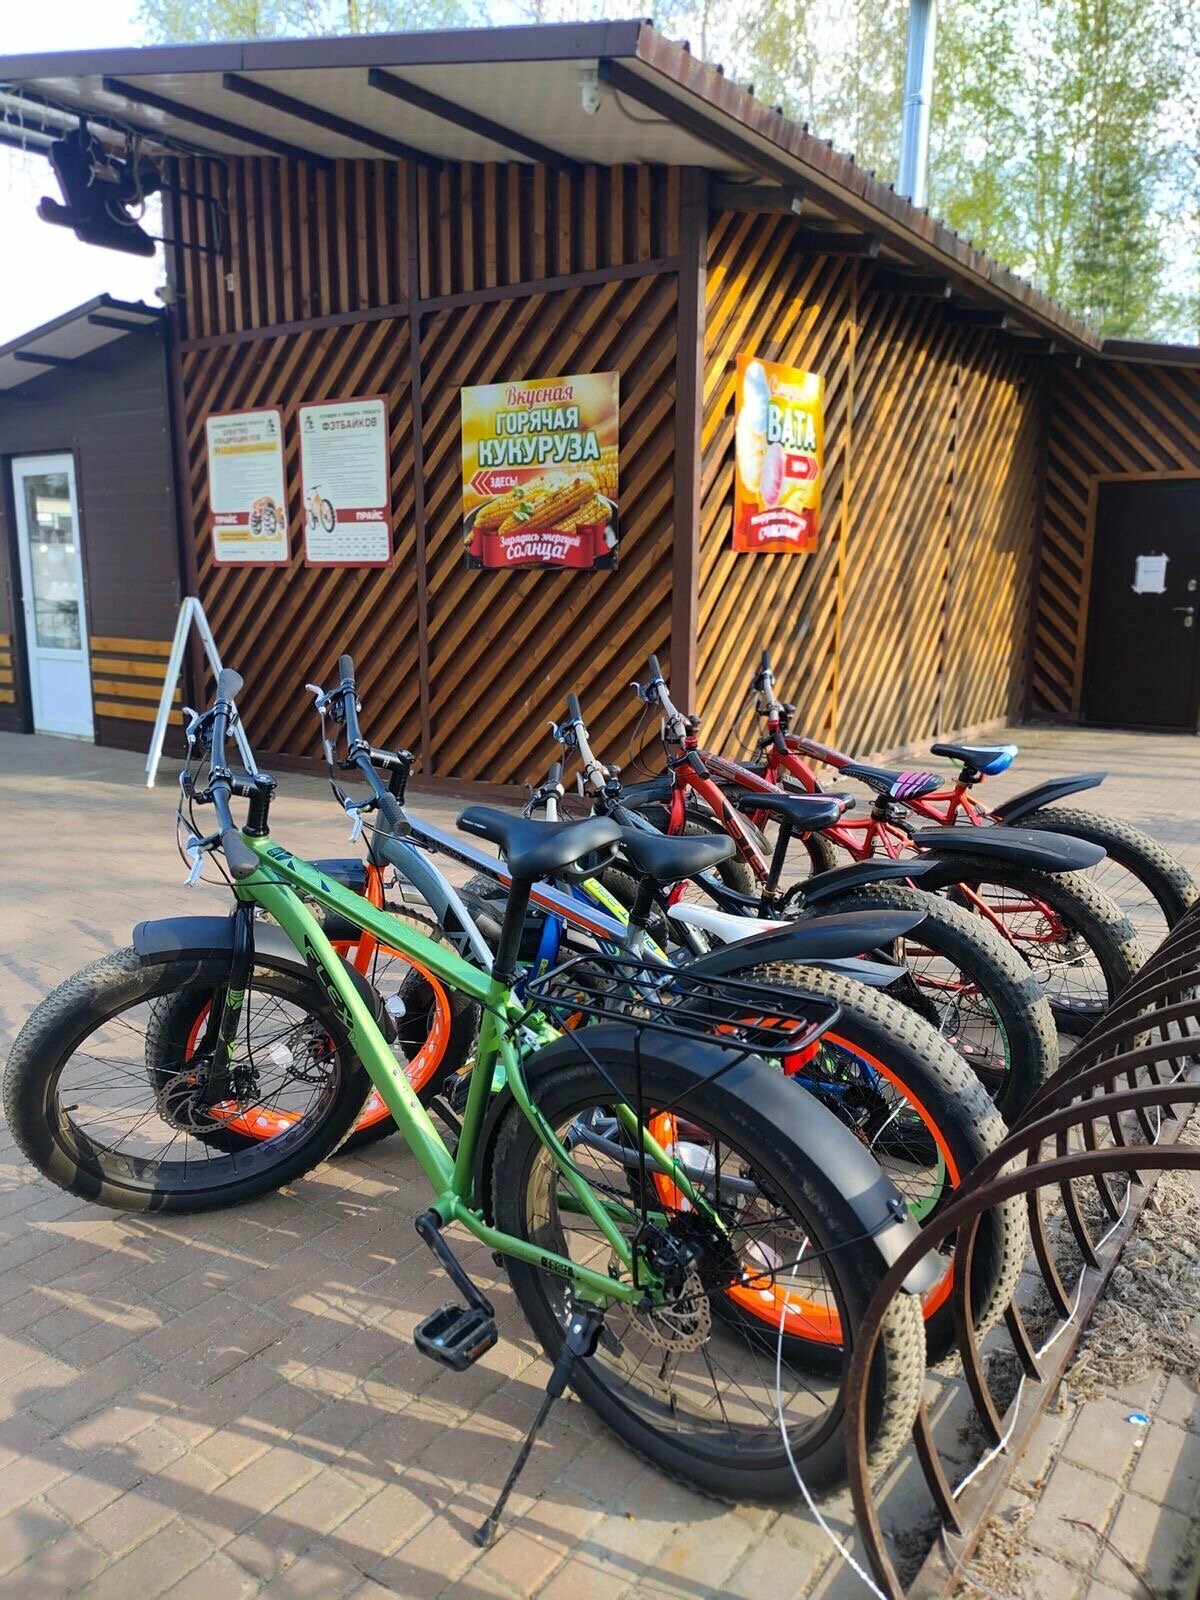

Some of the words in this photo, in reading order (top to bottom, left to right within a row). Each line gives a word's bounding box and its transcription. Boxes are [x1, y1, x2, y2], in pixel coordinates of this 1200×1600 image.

[505, 385, 574, 410] Вкусная
[322, 417, 377, 431] ФЭТБАЙКОВ
[496, 406, 580, 435] ГОРЯЧАЯ
[767, 401, 817, 453] ВАТА
[478, 431, 601, 466] КУКУРУЗА
[304, 945, 354, 1032] FLEX
